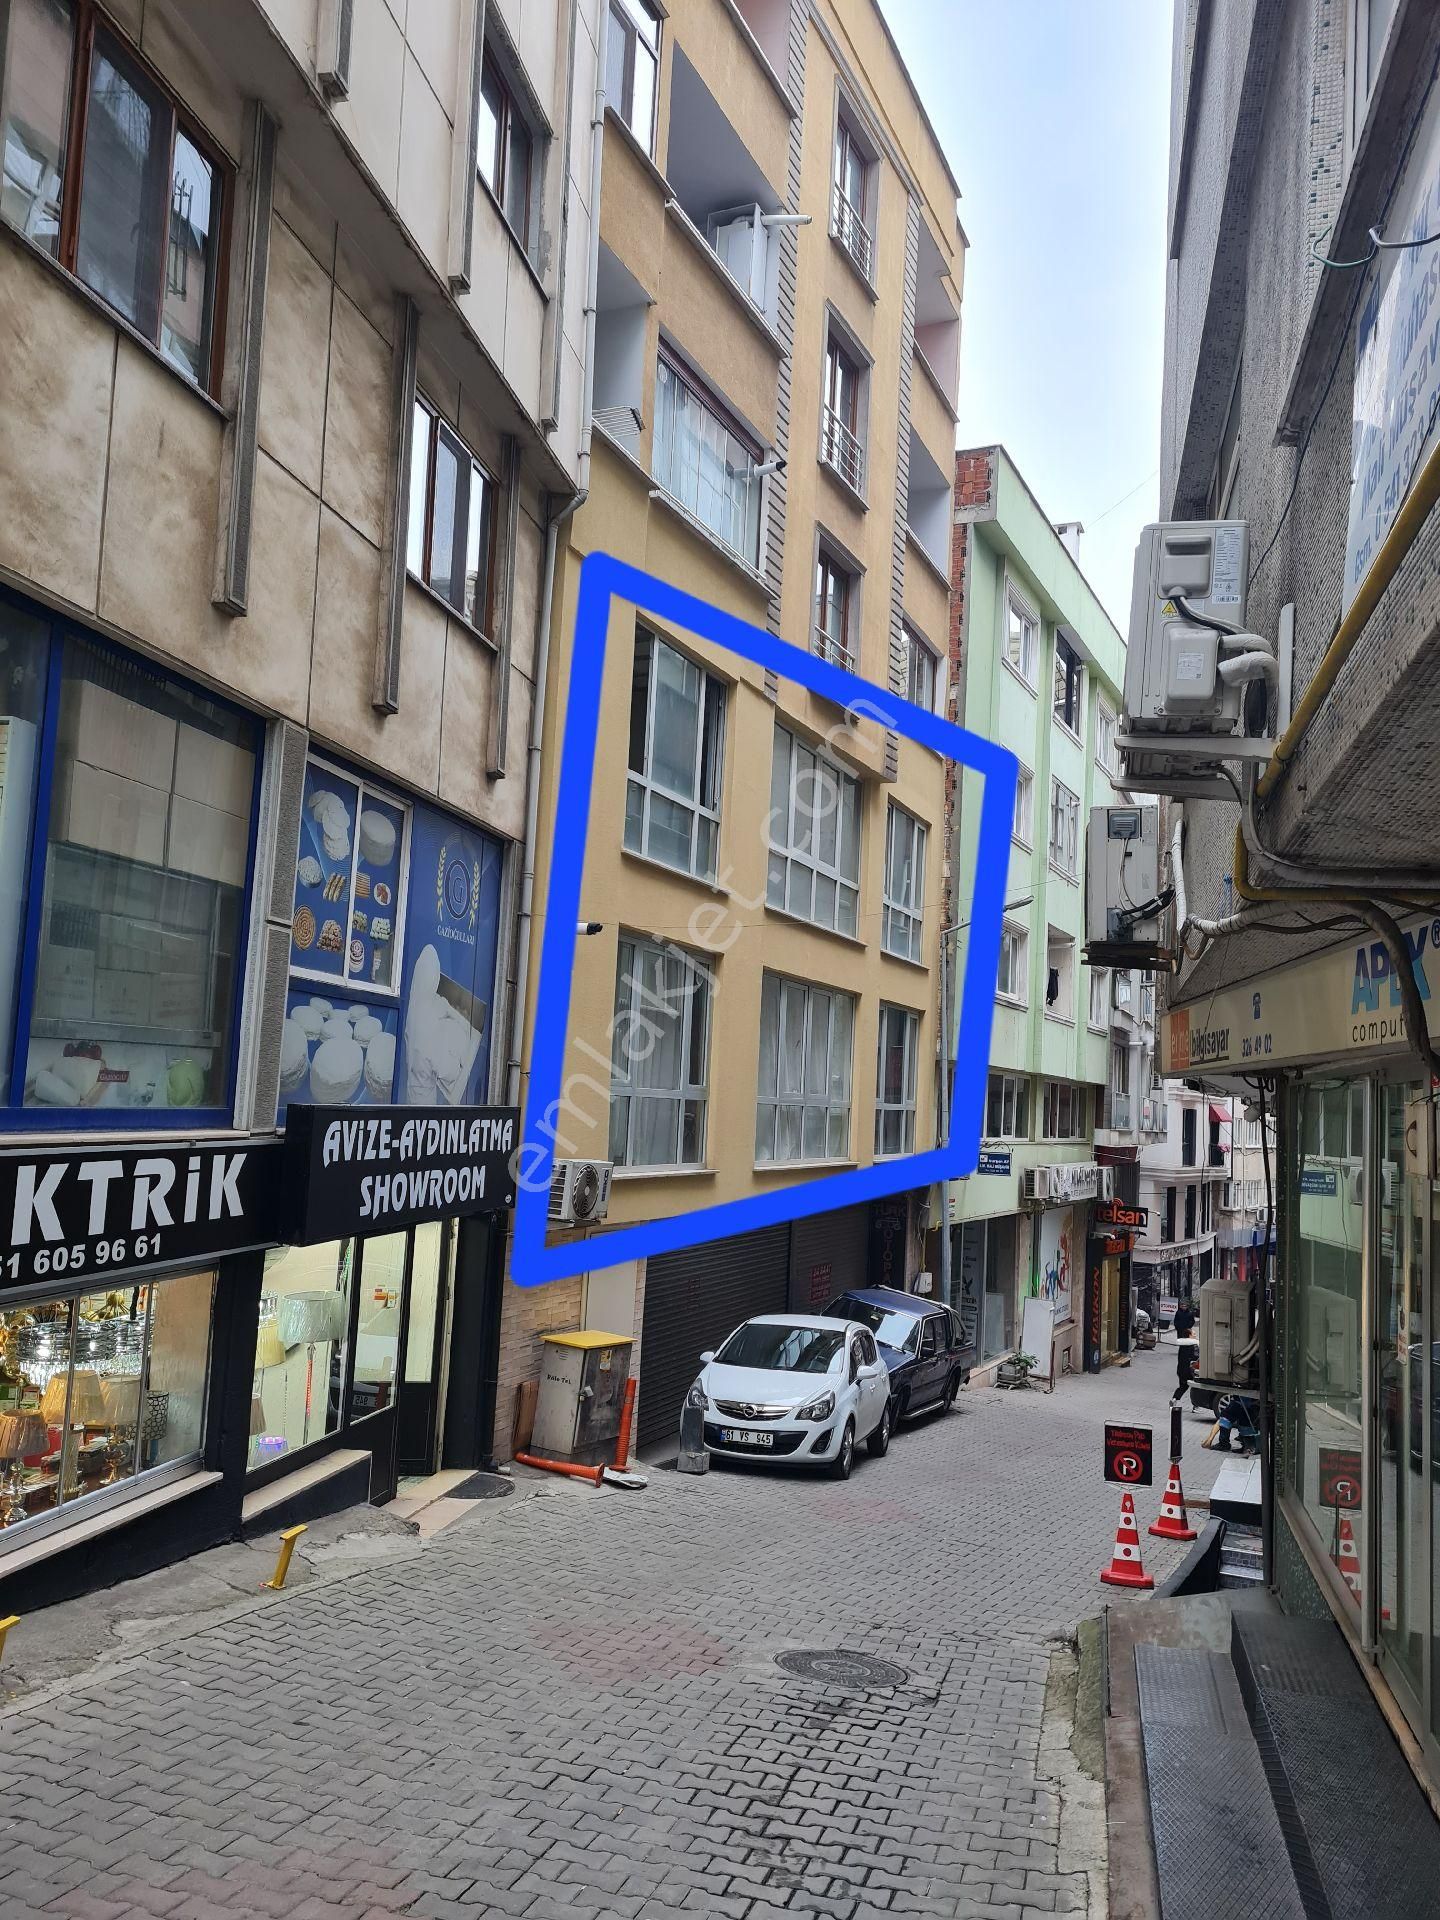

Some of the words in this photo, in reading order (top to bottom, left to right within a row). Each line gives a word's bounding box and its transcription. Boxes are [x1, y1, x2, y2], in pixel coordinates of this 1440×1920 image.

[1361, 431, 1386, 520] Mali
[1375, 503, 1382, 541] 0
[1384, 463, 1401, 525] 541
[437, 925, 475, 945] GAZİOĞULLARI
[1191, 1027, 1230, 1060] bilgisayar
[1352, 1012, 1407, 1045] comput
[1241, 1037, 1252, 1058] 326
[1264, 1033, 1273, 1054] 02
[322, 1118, 513, 1168] AVİZE-AYDINLATMA
[359, 1165, 487, 1220] SHOWROOM
[1097, 1204, 1147, 1226] telsan
[0, 1253, 20, 1279] 1
[33, 1244, 86, 1275] 605
[95, 1238, 126, 1265] 96
[134, 1233, 161, 1258] 61
[726, 1430, 734, 1440] 61
[739, 1431, 750, 1442] VS
[756, 1433, 771, 1445] 945
